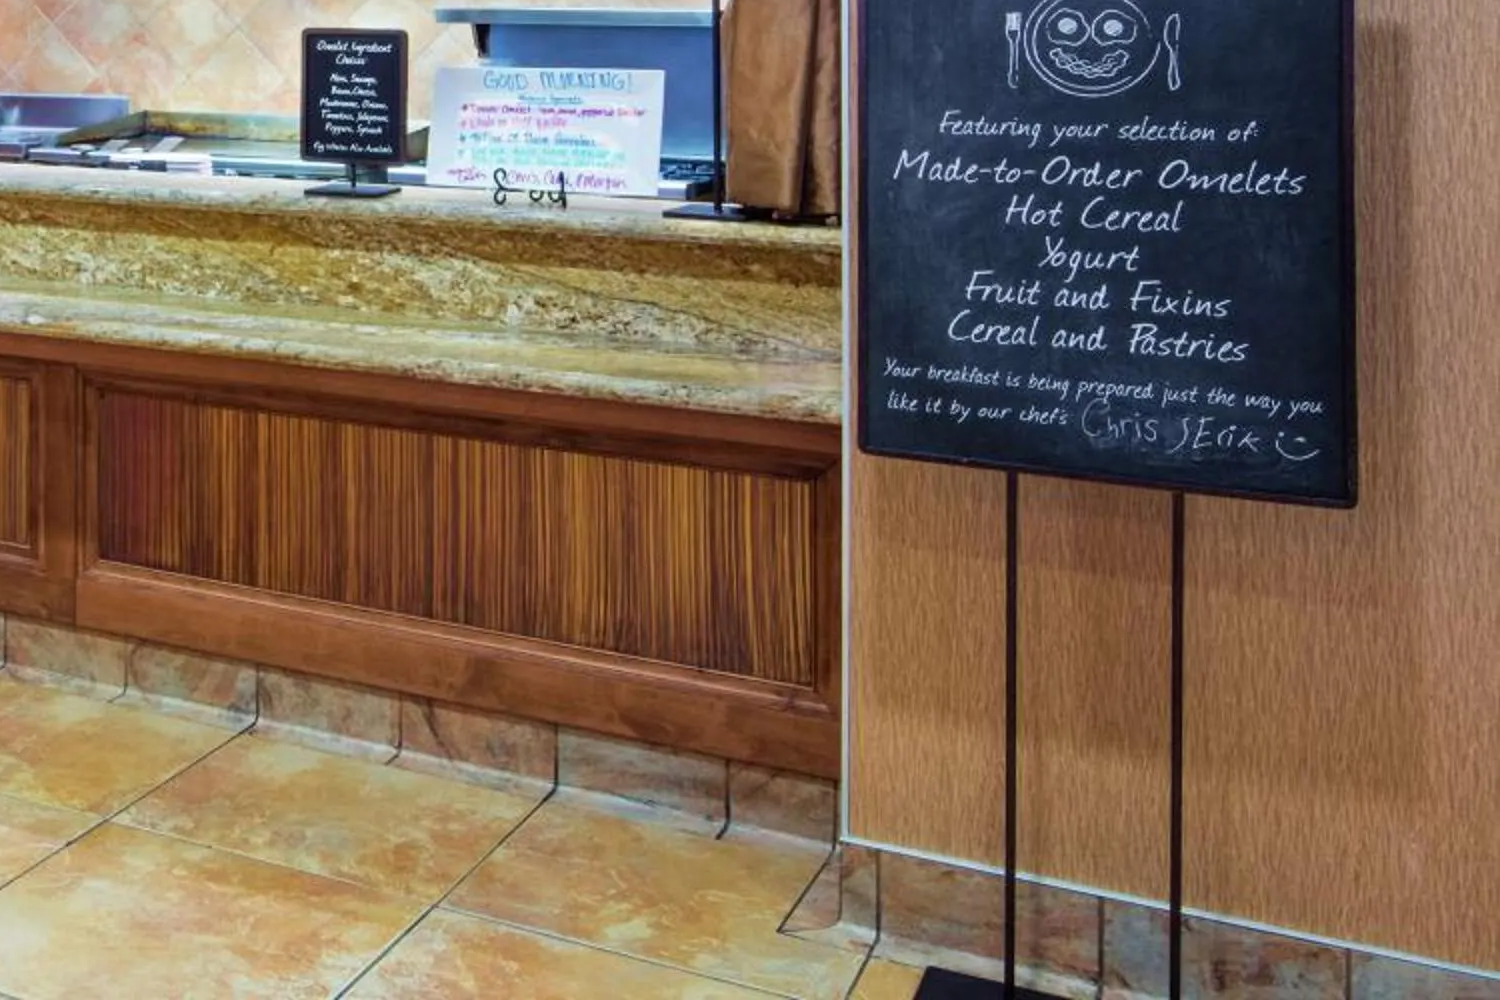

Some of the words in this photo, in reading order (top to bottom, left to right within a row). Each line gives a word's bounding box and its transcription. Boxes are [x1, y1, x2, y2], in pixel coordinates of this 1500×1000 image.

[939, 109, 1041, 149] Featuring
[1050, 123, 1109, 147] your
[1117, 115, 1215, 142] selection
[893, 149, 1143, 190] Made-to-Order
[1158, 159, 1307, 195] Omelets
[1005, 194, 1063, 228] Hot
[1080, 196, 1184, 233] Cereal
[1038, 235, 1140, 283] Yogurt
[965, 270, 1041, 305] Fruit
[1054, 284, 1110, 310] and
[1130, 279, 1232, 318] Fixins
[947, 309, 1041, 346] Cereal
[1051, 325, 1108, 351] and
[1129, 323, 1250, 363] Pastries
[883, 357, 922, 378] Your
[927, 366, 1002, 386] breakfast
[1005, 371, 1021, 388] is
[1029, 373, 1071, 401] being
[1076, 382, 1156, 404] prepared
[1161, 382, 1199, 407] just
[1206, 387, 1236, 407] the
[1245, 395, 1281, 419] way
[1287, 400, 1324, 419] you
[887, 389, 918, 412] like
[925, 396, 942, 413] it
[950, 398, 971, 424] by
[977, 407, 1013, 420] our
[1081, 397, 1159, 442] Chris
